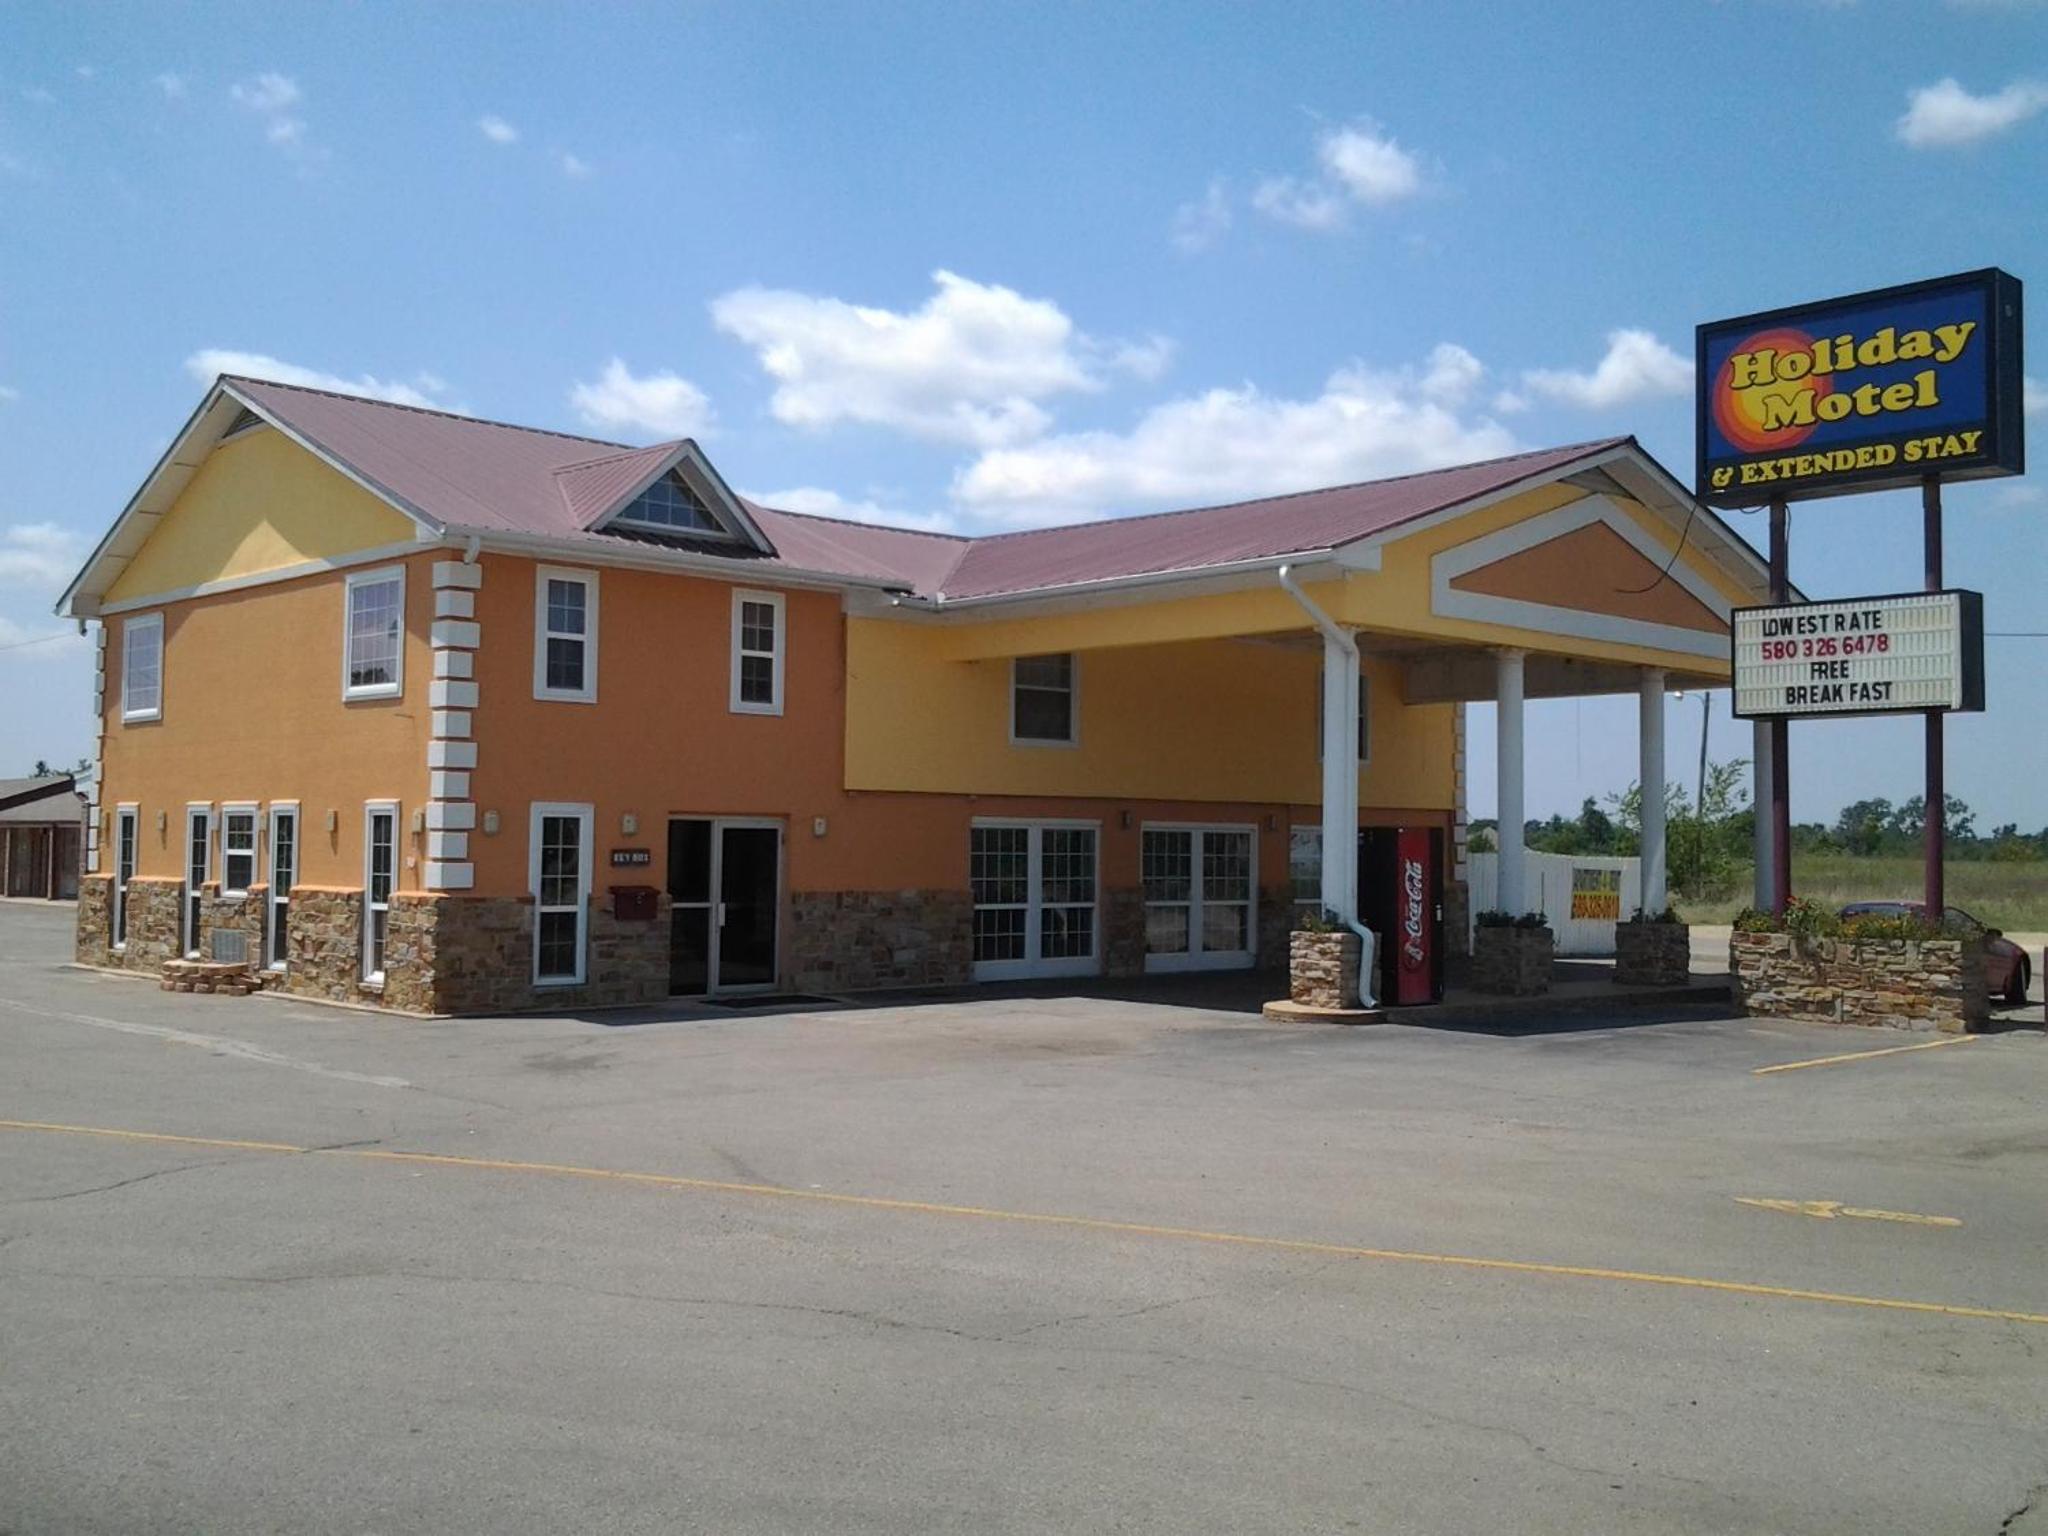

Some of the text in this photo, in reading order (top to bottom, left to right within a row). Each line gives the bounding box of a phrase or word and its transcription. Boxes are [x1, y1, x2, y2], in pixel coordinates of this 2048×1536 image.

[1729, 321, 1976, 390] Holiday
[1762, 369, 1940, 431] Motel
[1711, 430, 1983, 488] & EXTENDED STAY
[1762, 610, 1882, 637] LOWEST RATE
[1761, 633, 1889, 661] 580 326 6478
[1810, 660, 1849, 681] FREE
